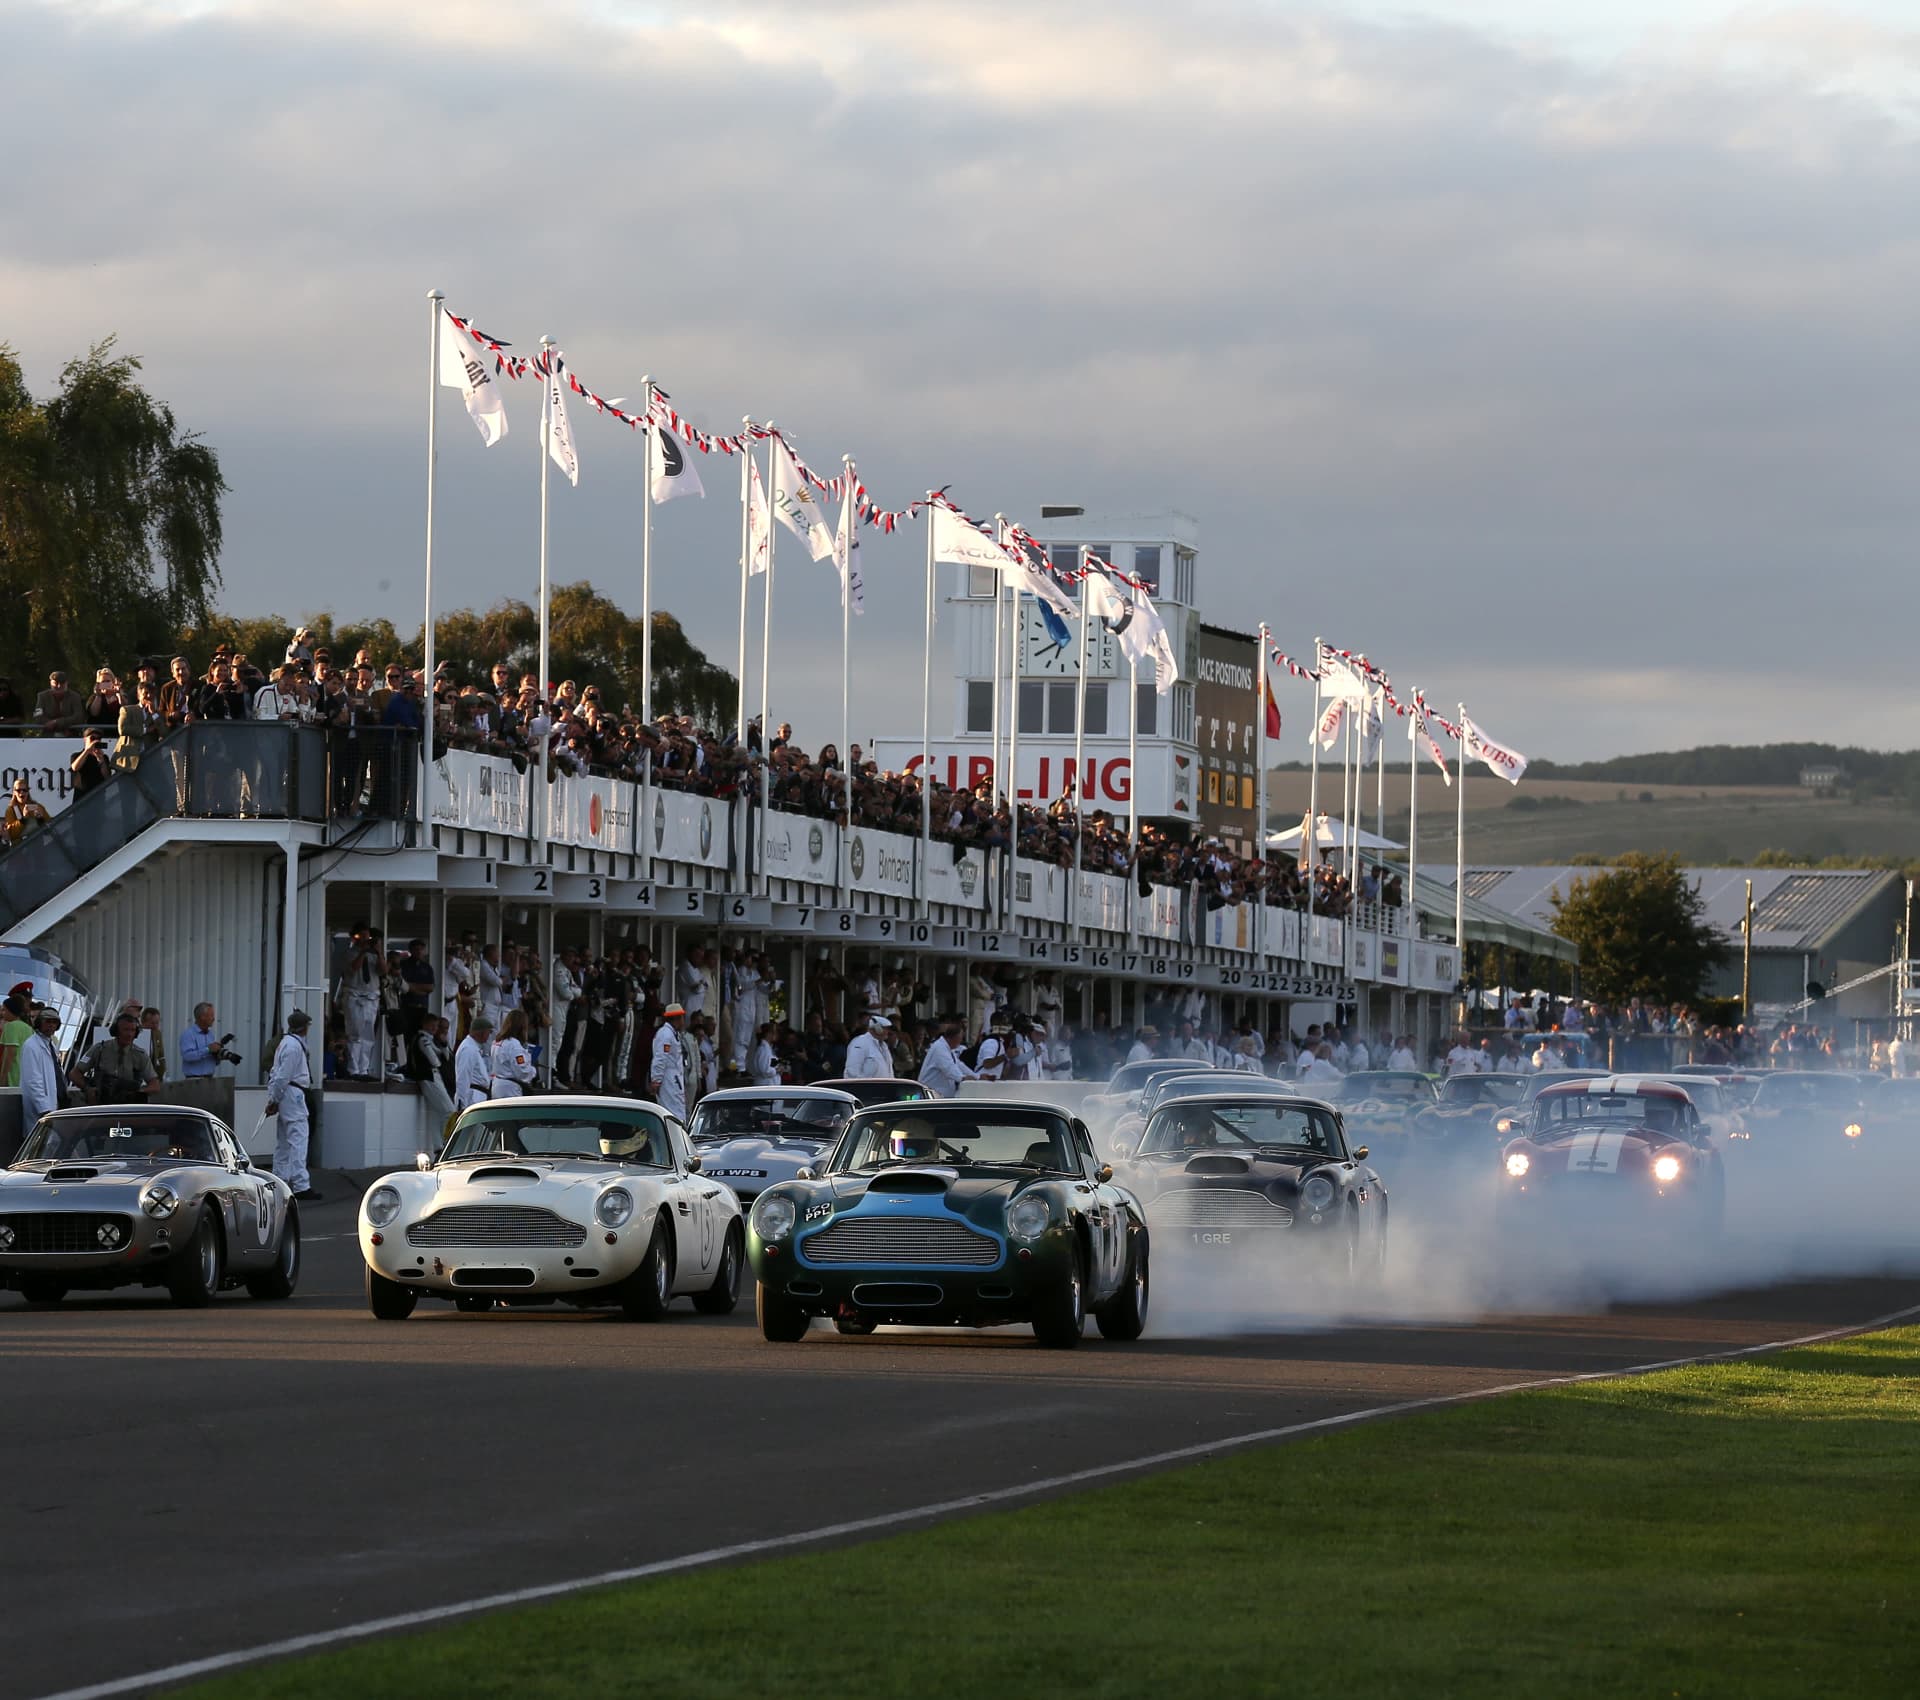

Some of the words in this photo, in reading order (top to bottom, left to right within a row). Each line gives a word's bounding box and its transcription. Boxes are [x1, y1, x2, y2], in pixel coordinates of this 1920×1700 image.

[774, 489, 817, 537] OLEX
[939, 545, 1009, 561] JAGUA
[1198, 658, 1214, 682] ACE
[1215, 662, 1252, 690] POSITIONS
[1482, 744, 1518, 769] UBS
[1, 767, 73, 800] grap
[486, 863, 491, 882] 1
[534, 871, 547, 890] 2
[589, 879, 600, 898] 3
[637, 886, 650, 904] 4
[687, 893, 698, 911] 5
[733, 900, 745, 916] 6
[798, 909, 809, 925] 7
[840, 914, 851, 930] 8
[880, 920, 891, 936] 9
[910, 925, 928, 941] 10
[953, 931, 964, 946] 11
[982, 936, 999, 951] 12
[1030, 943, 1047, 957] 14
[1063, 947, 1079, 962] 15
[1092, 952, 1108, 966] 16
[1122, 956, 1137, 970] 17
[1150, 961, 1165, 974] 18
[1178, 964, 1193, 977] 19
[1220, 970, 1240, 984] 20
[1251, 975, 1266, 988] 21
[1269, 977, 1288, 990] 22
[1293, 981, 1311, 994] 23
[1315, 984, 1333, 996] 24
[1337, 987, 1355, 999] 25
[805, 1203, 830, 1214] 170
[805, 1209, 830, 1222] PPL
[1202, 1233, 1232, 1244] GRE
